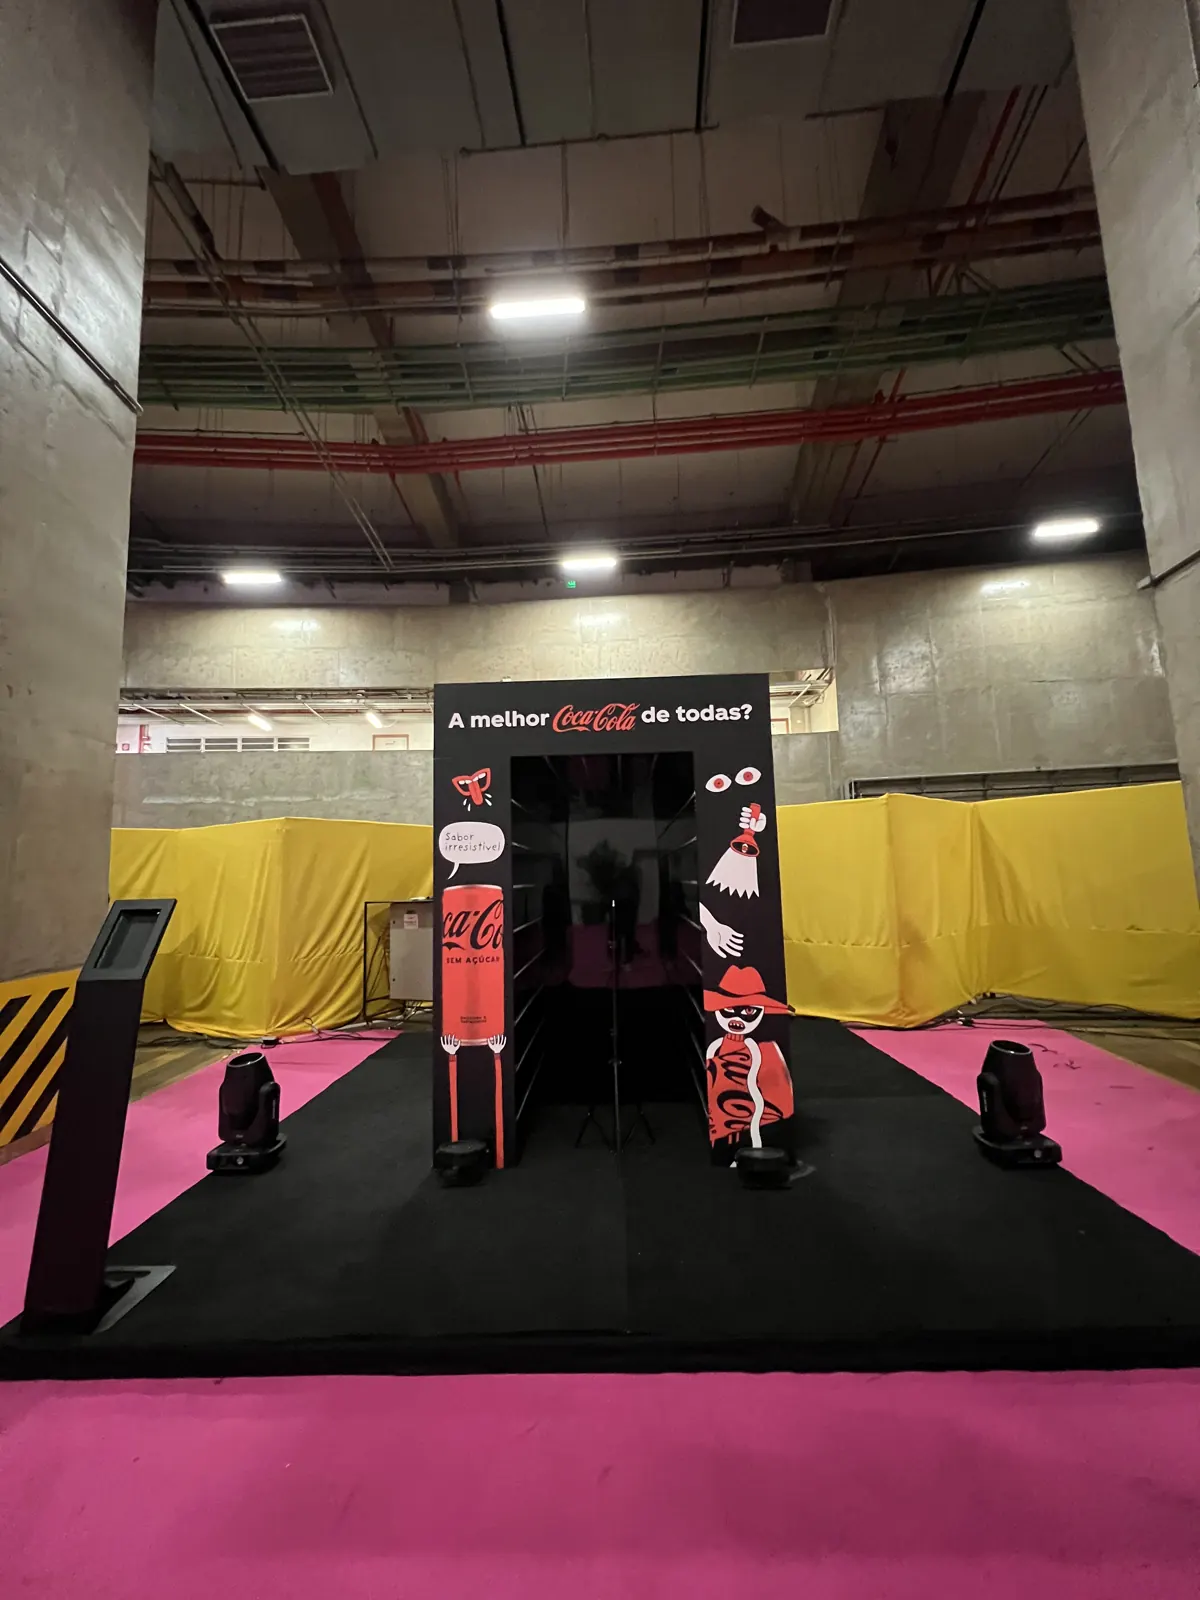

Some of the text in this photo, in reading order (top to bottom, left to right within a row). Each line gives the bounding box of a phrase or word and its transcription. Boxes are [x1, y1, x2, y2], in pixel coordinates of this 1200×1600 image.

[448, 702, 753, 733] A melhor Coca-Cola de todas?
[445, 832, 474, 842] Sabor
